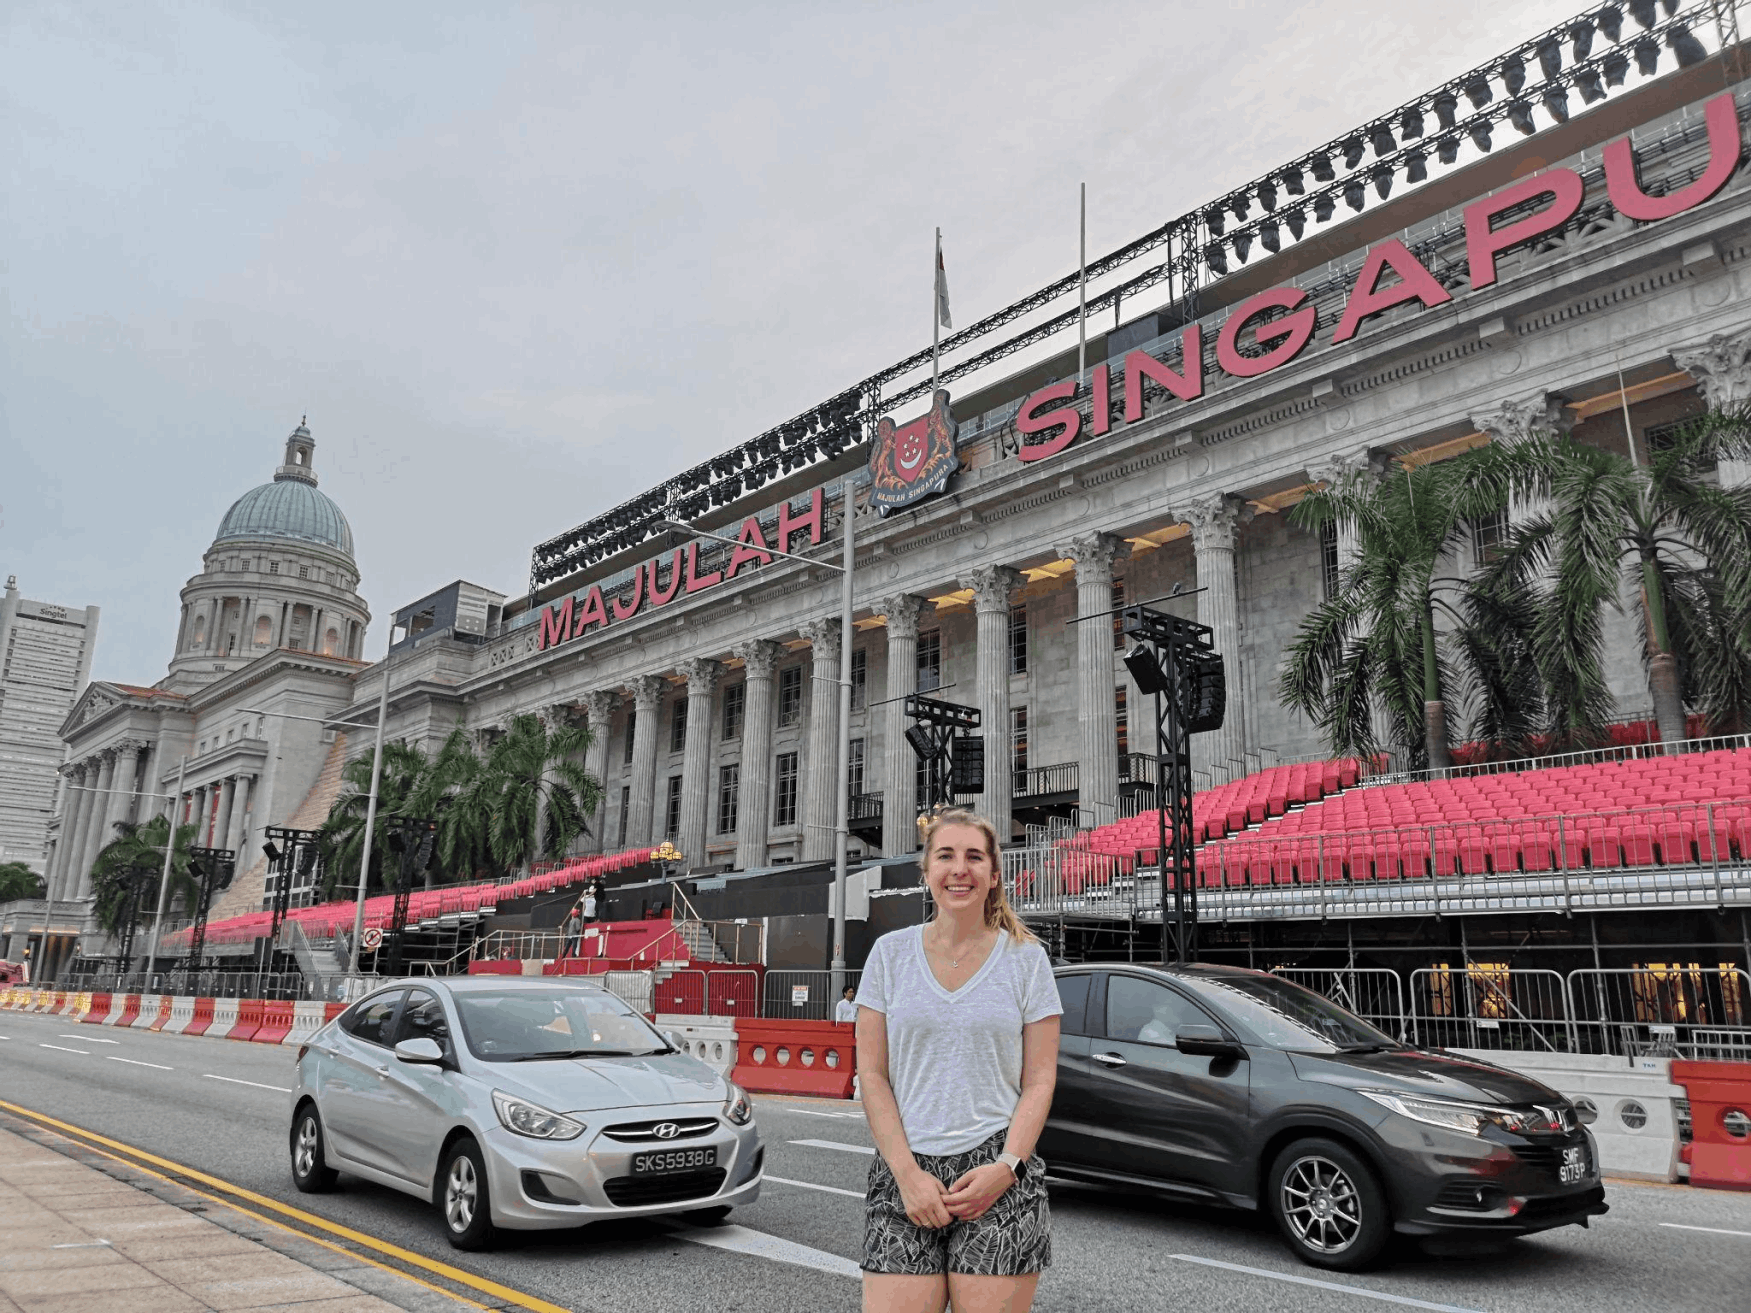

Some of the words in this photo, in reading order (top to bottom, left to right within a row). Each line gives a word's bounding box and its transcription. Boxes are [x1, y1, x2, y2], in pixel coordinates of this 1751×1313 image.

[538, 487, 825, 650] MAJULAH
[1016, 93, 1740, 462] SINGAPU
[877, 492, 905, 502] MAJULAH
[908, 464, 948, 498] SINGAPURA
[40, 608, 67, 619] Singtel
[635, 1150, 714, 1172] SKS5938G
[1562, 1147, 1578, 1164] SMF
[1560, 1162, 1585, 1181] 9173P
